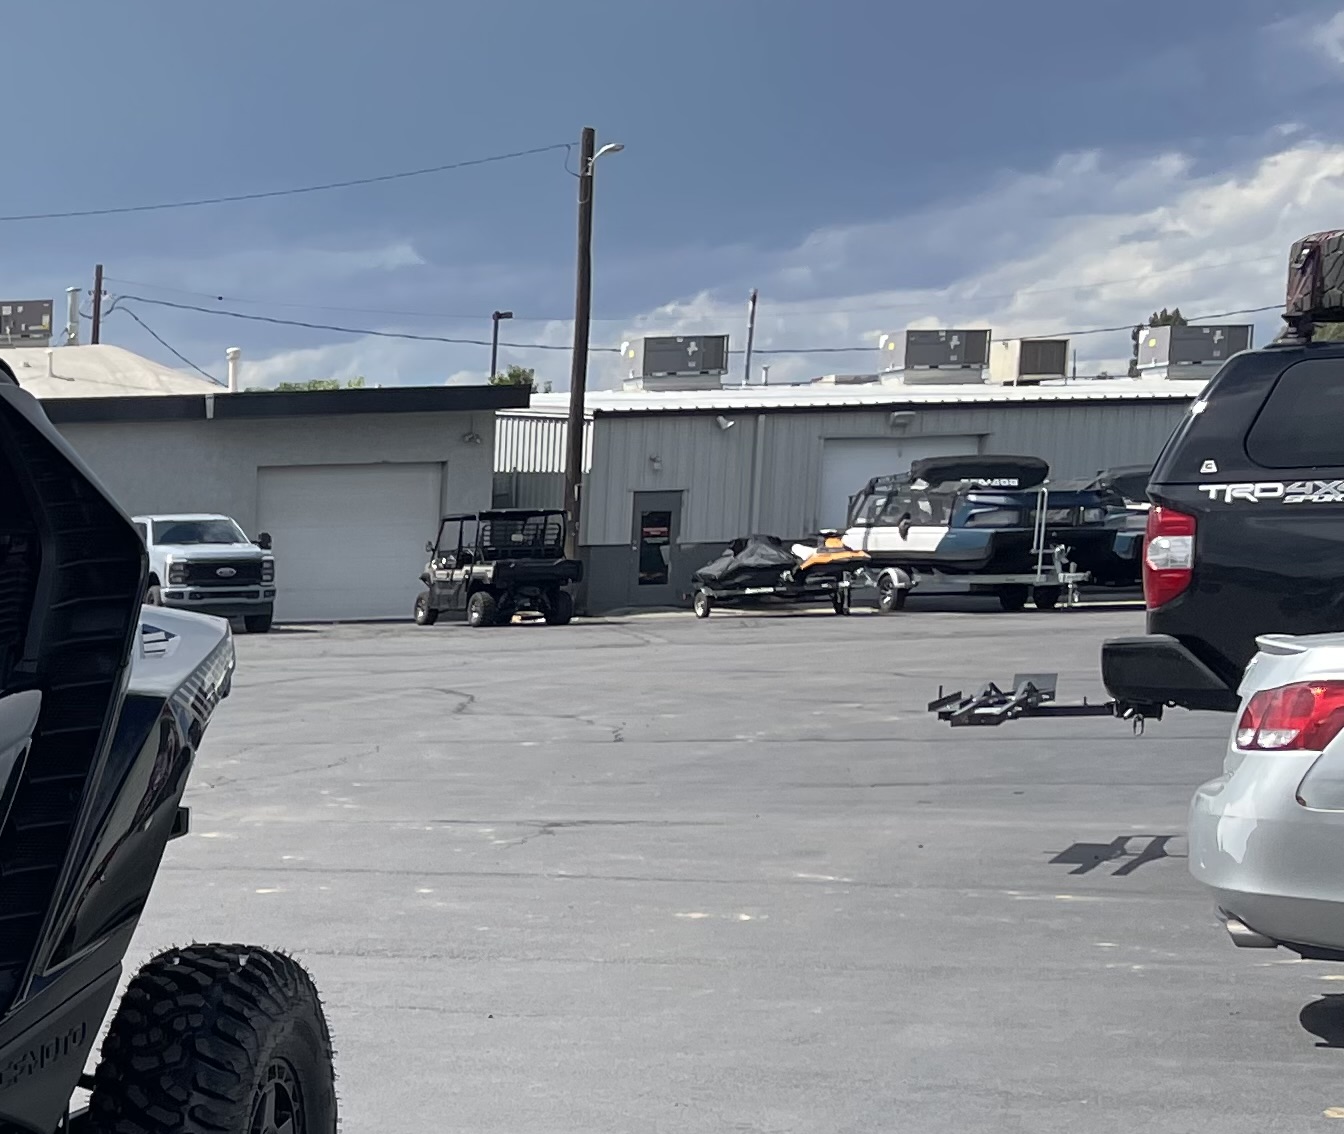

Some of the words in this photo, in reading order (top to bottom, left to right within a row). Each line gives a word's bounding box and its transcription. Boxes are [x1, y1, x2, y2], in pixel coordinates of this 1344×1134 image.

[1198, 482, 1284, 503] TRD
[1285, 480, 1344, 495] 4X
[1282, 494, 1344, 503] SPOR
